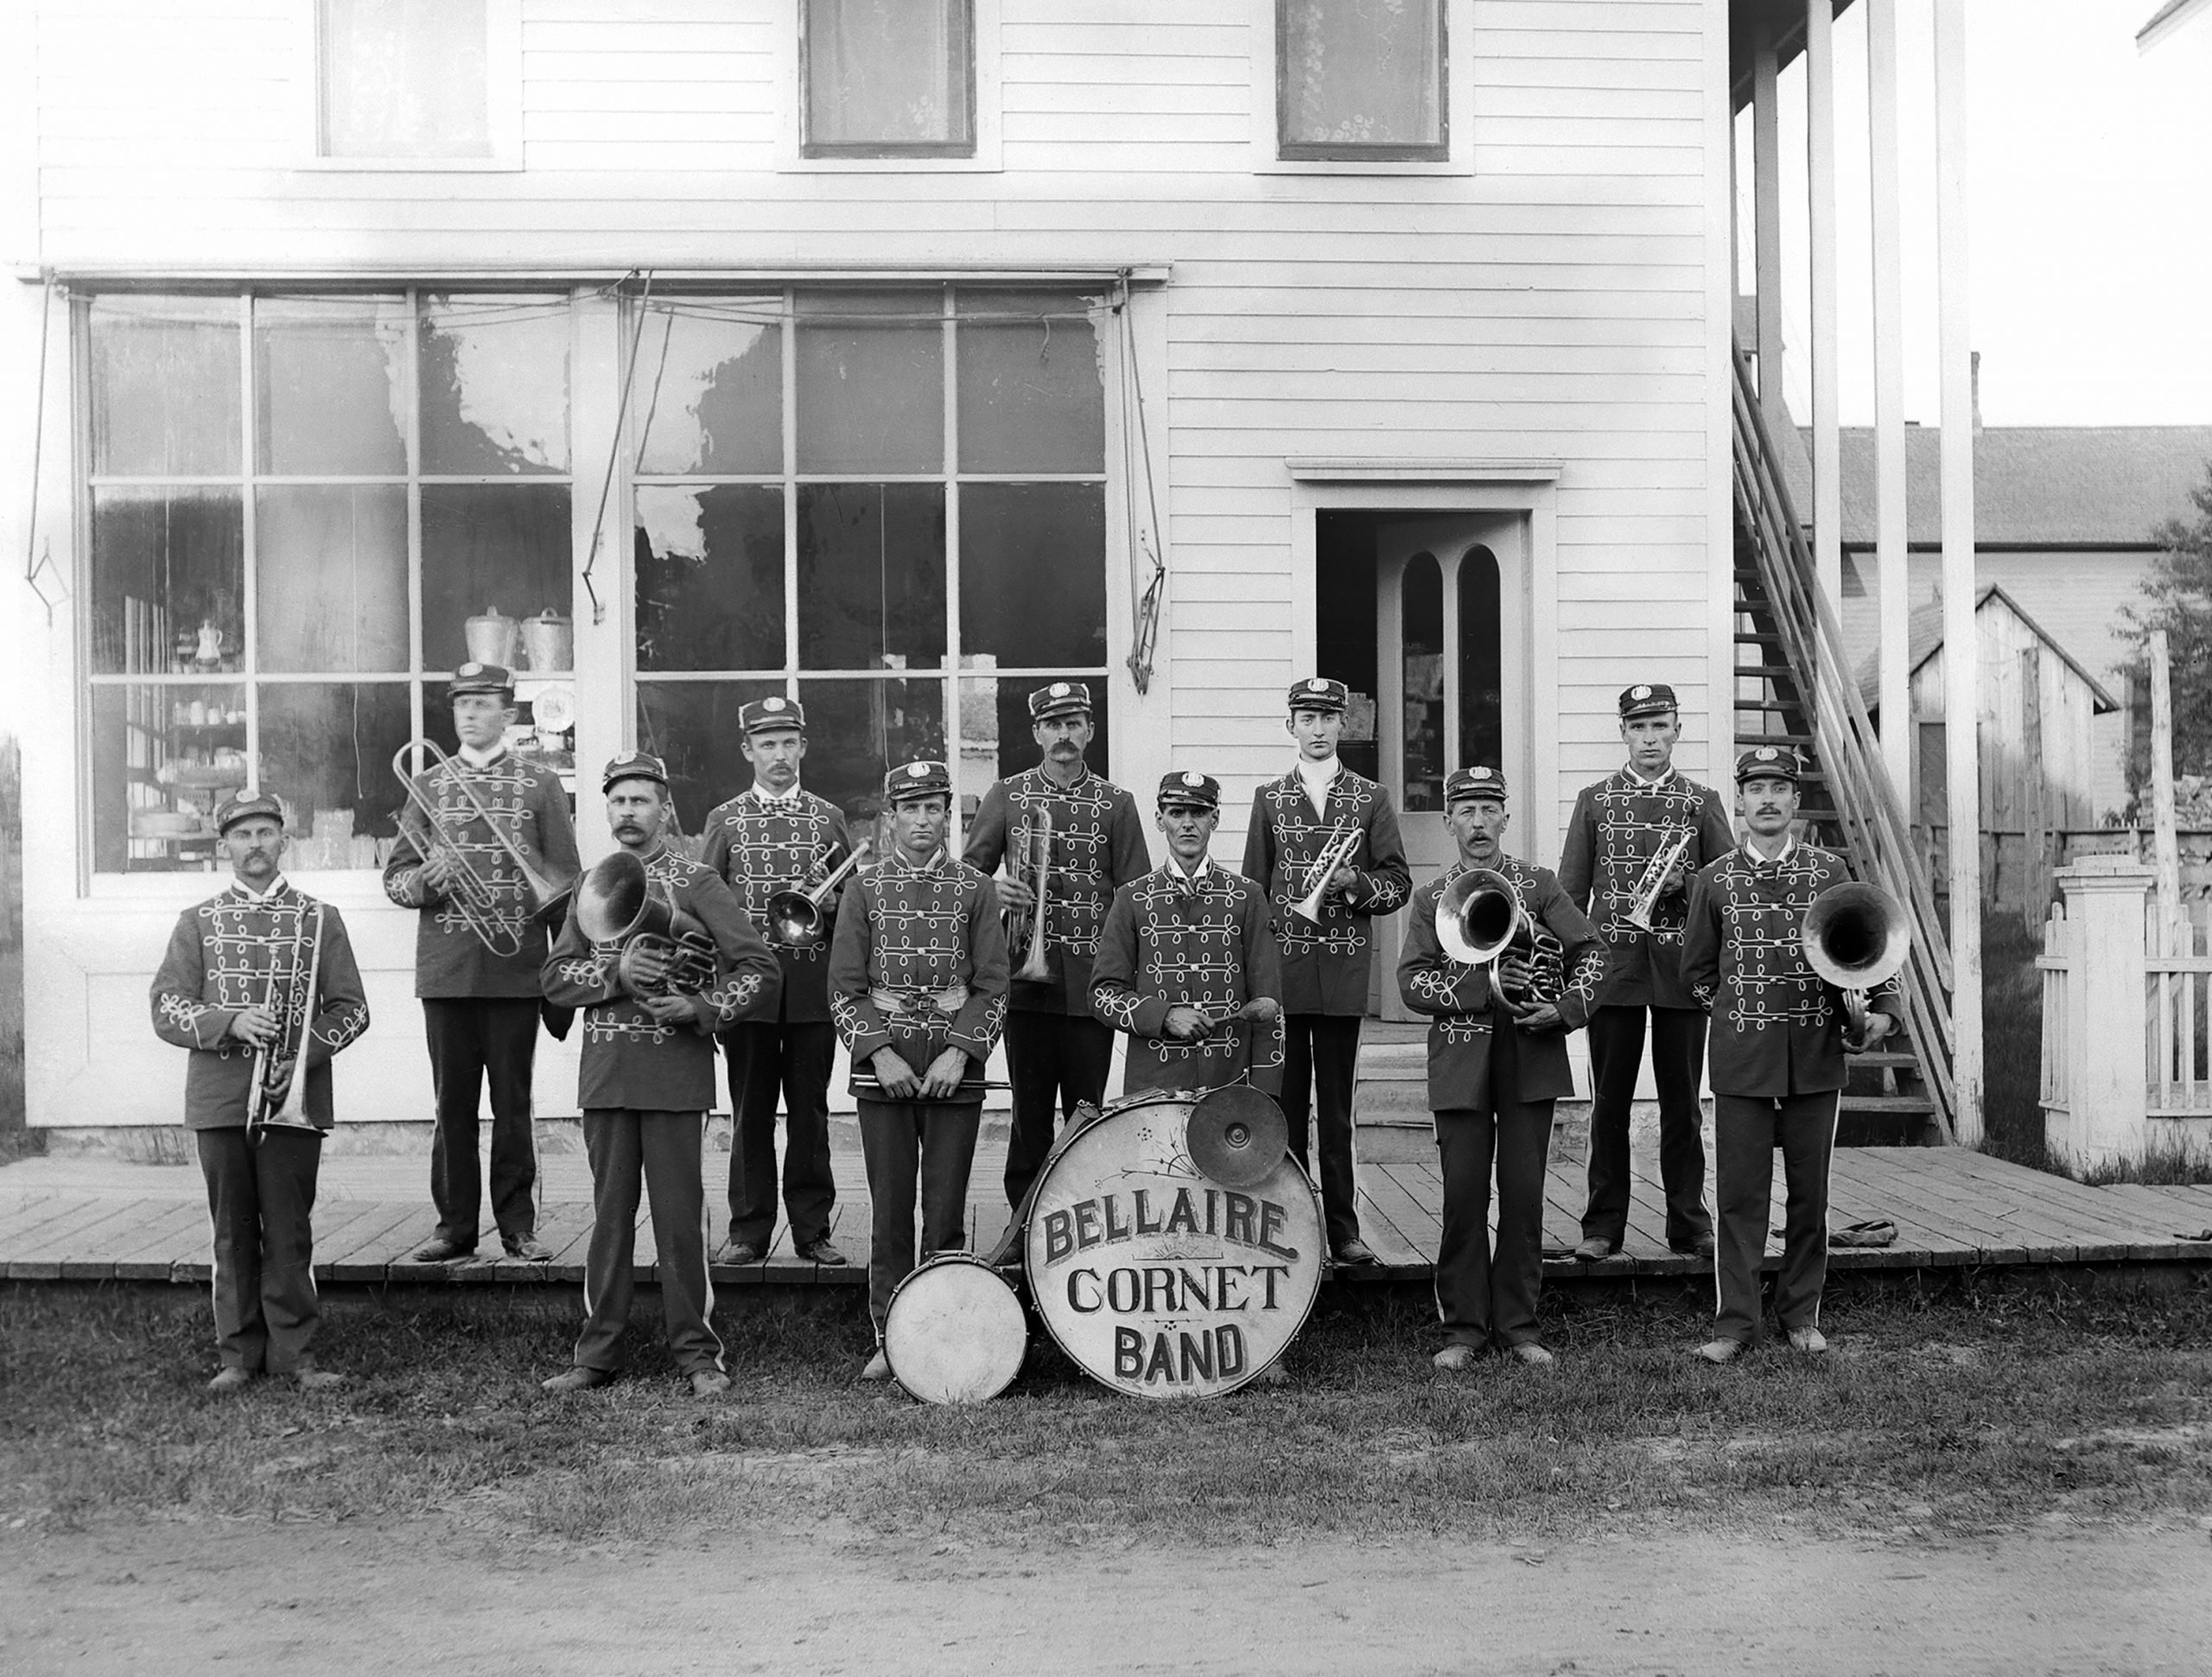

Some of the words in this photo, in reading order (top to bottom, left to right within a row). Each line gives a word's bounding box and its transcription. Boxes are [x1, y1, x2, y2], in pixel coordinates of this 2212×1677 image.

[1042, 1188, 1299, 1266] BELLAIRE
[1067, 1267, 1289, 1313] CORNET
[1116, 1324, 1248, 1383] BAND
